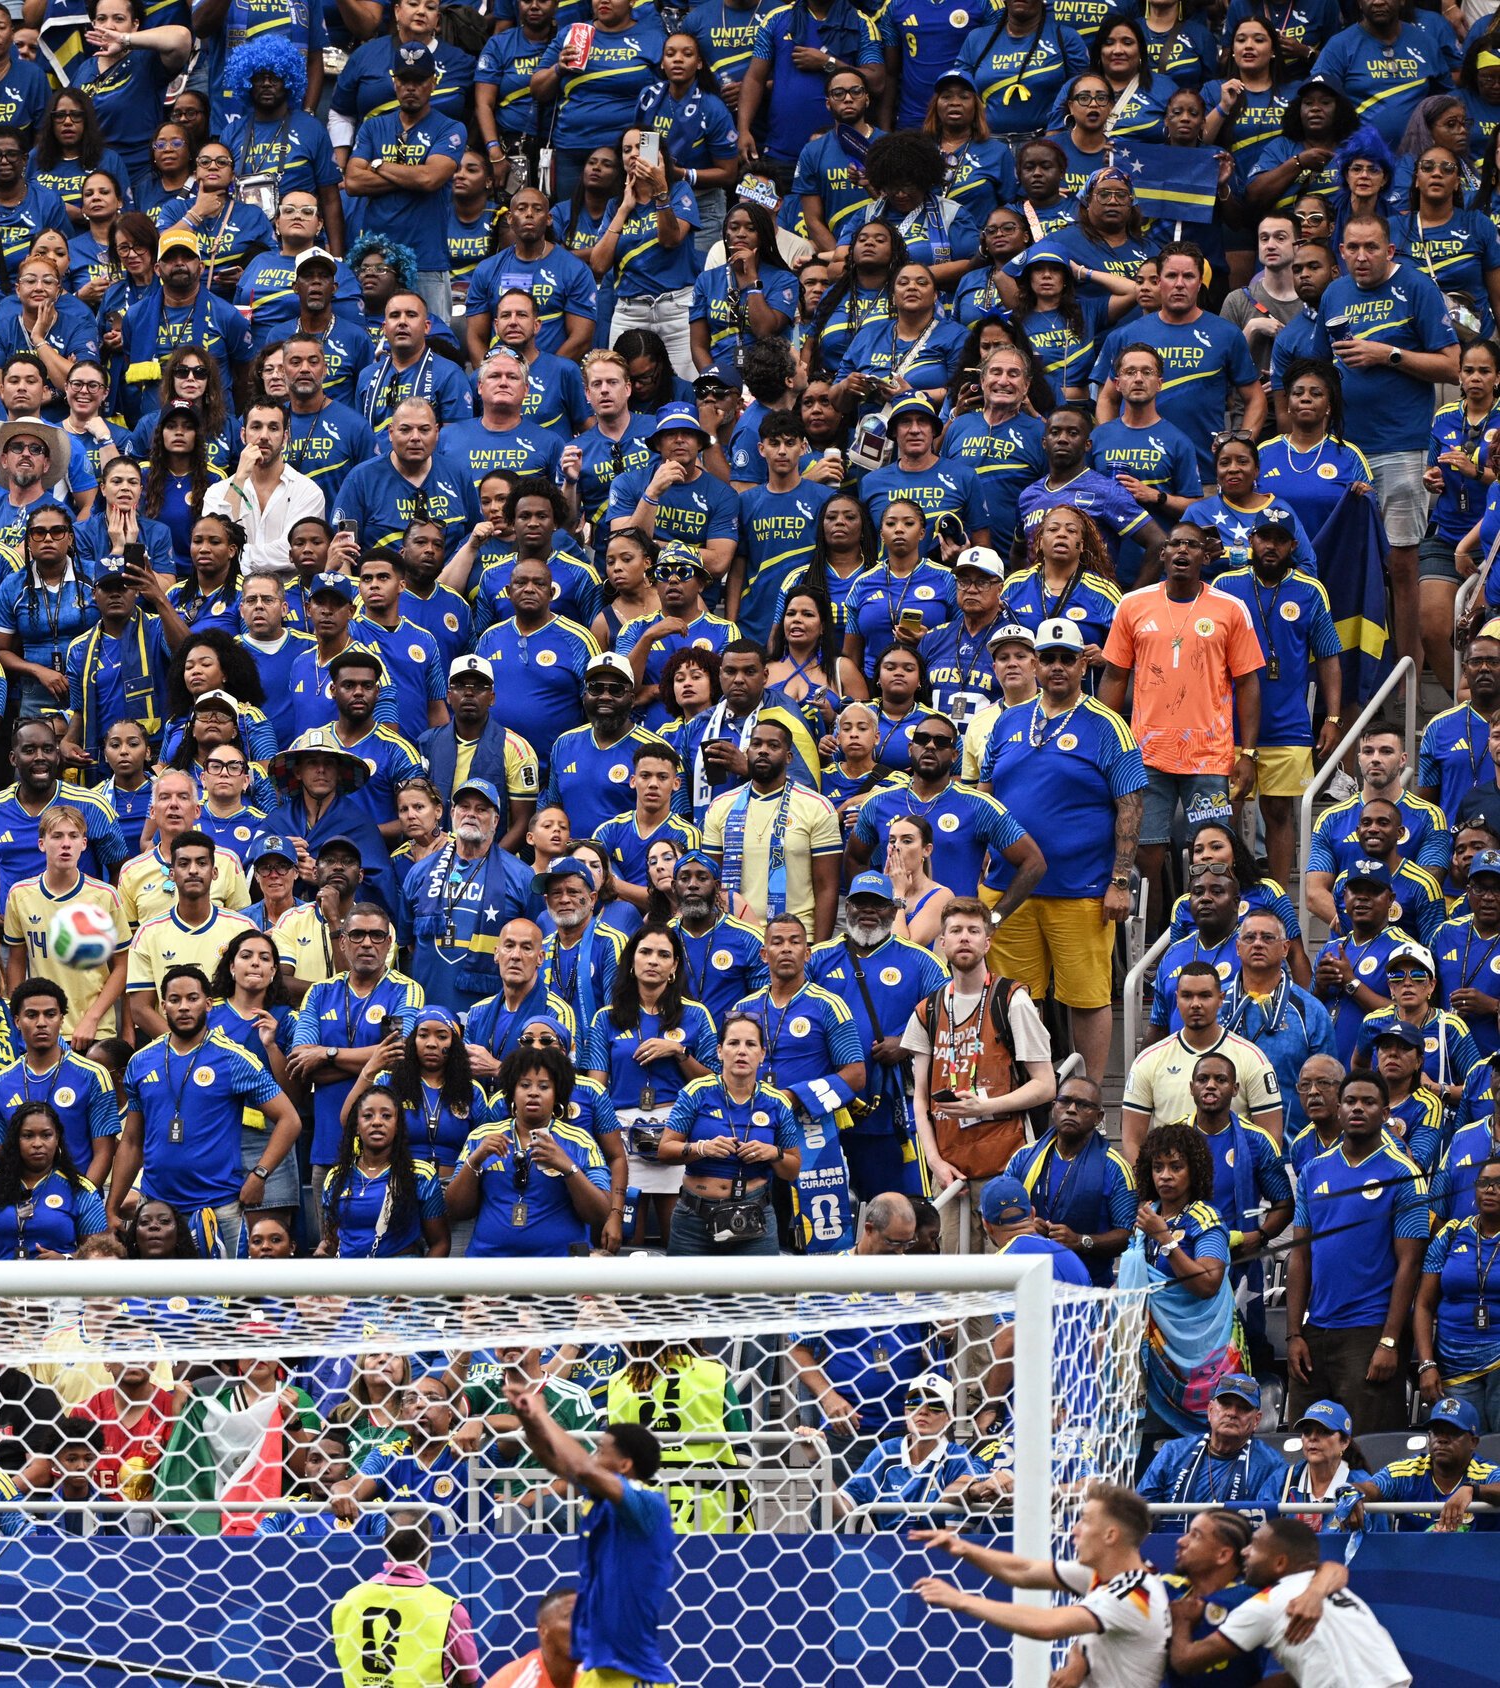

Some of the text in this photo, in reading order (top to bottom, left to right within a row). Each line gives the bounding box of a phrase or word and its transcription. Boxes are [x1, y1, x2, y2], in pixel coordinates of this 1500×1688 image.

[1053, 1, 1107, 14] UNITED
[1054, 13, 1104, 23] WE PLAY
[712, 37, 756, 47] WE PLA
[905, 32, 918, 57] 9
[589, 48, 637, 58] UNITED
[1367, 59, 1418, 71] UNITED
[1371, 71, 1388, 79] WE
[1241, 107, 1285, 117] NITED
[735, 184, 777, 210] CURAÇAO
[1411, 240, 1463, 253] UNITED
[1344, 299, 1393, 317] UNITED
[1363, 312, 1390, 322] PLAY
[1029, 329, 1073, 345] UNITE
[1155, 347, 1205, 359] NITED
[1169, 360, 1200, 368] PLAY
[961, 436, 1016, 454] UNITED
[302, 452, 330, 460] PLAY
[469, 449, 528, 461] UNITED
[961, 449, 1011, 460] WE PLAY
[470, 460, 525, 469] WE PLAY
[656, 505, 707, 525] UNITED
[672, 521, 702, 535] PLAY
[753, 516, 806, 532] UNITED
[756, 531, 803, 542] WE PLAY
[970, 551, 980, 562] C
[1052, 625, 1063, 639] C
[468, 658, 478, 669] C
[603, 656, 613, 665] C
[968, 671, 993, 690] TA
[1188, 804, 1233, 824] CURAÇAO
[428, 842, 455, 898] URAÇAO
[27, 931, 47, 958] 14
[1403, 946, 1413, 955] C
[932, 1043, 985, 1059] PARNER
[800, 1176, 844, 1190] CURAÇAO
[926, 1377, 937, 1387] C
